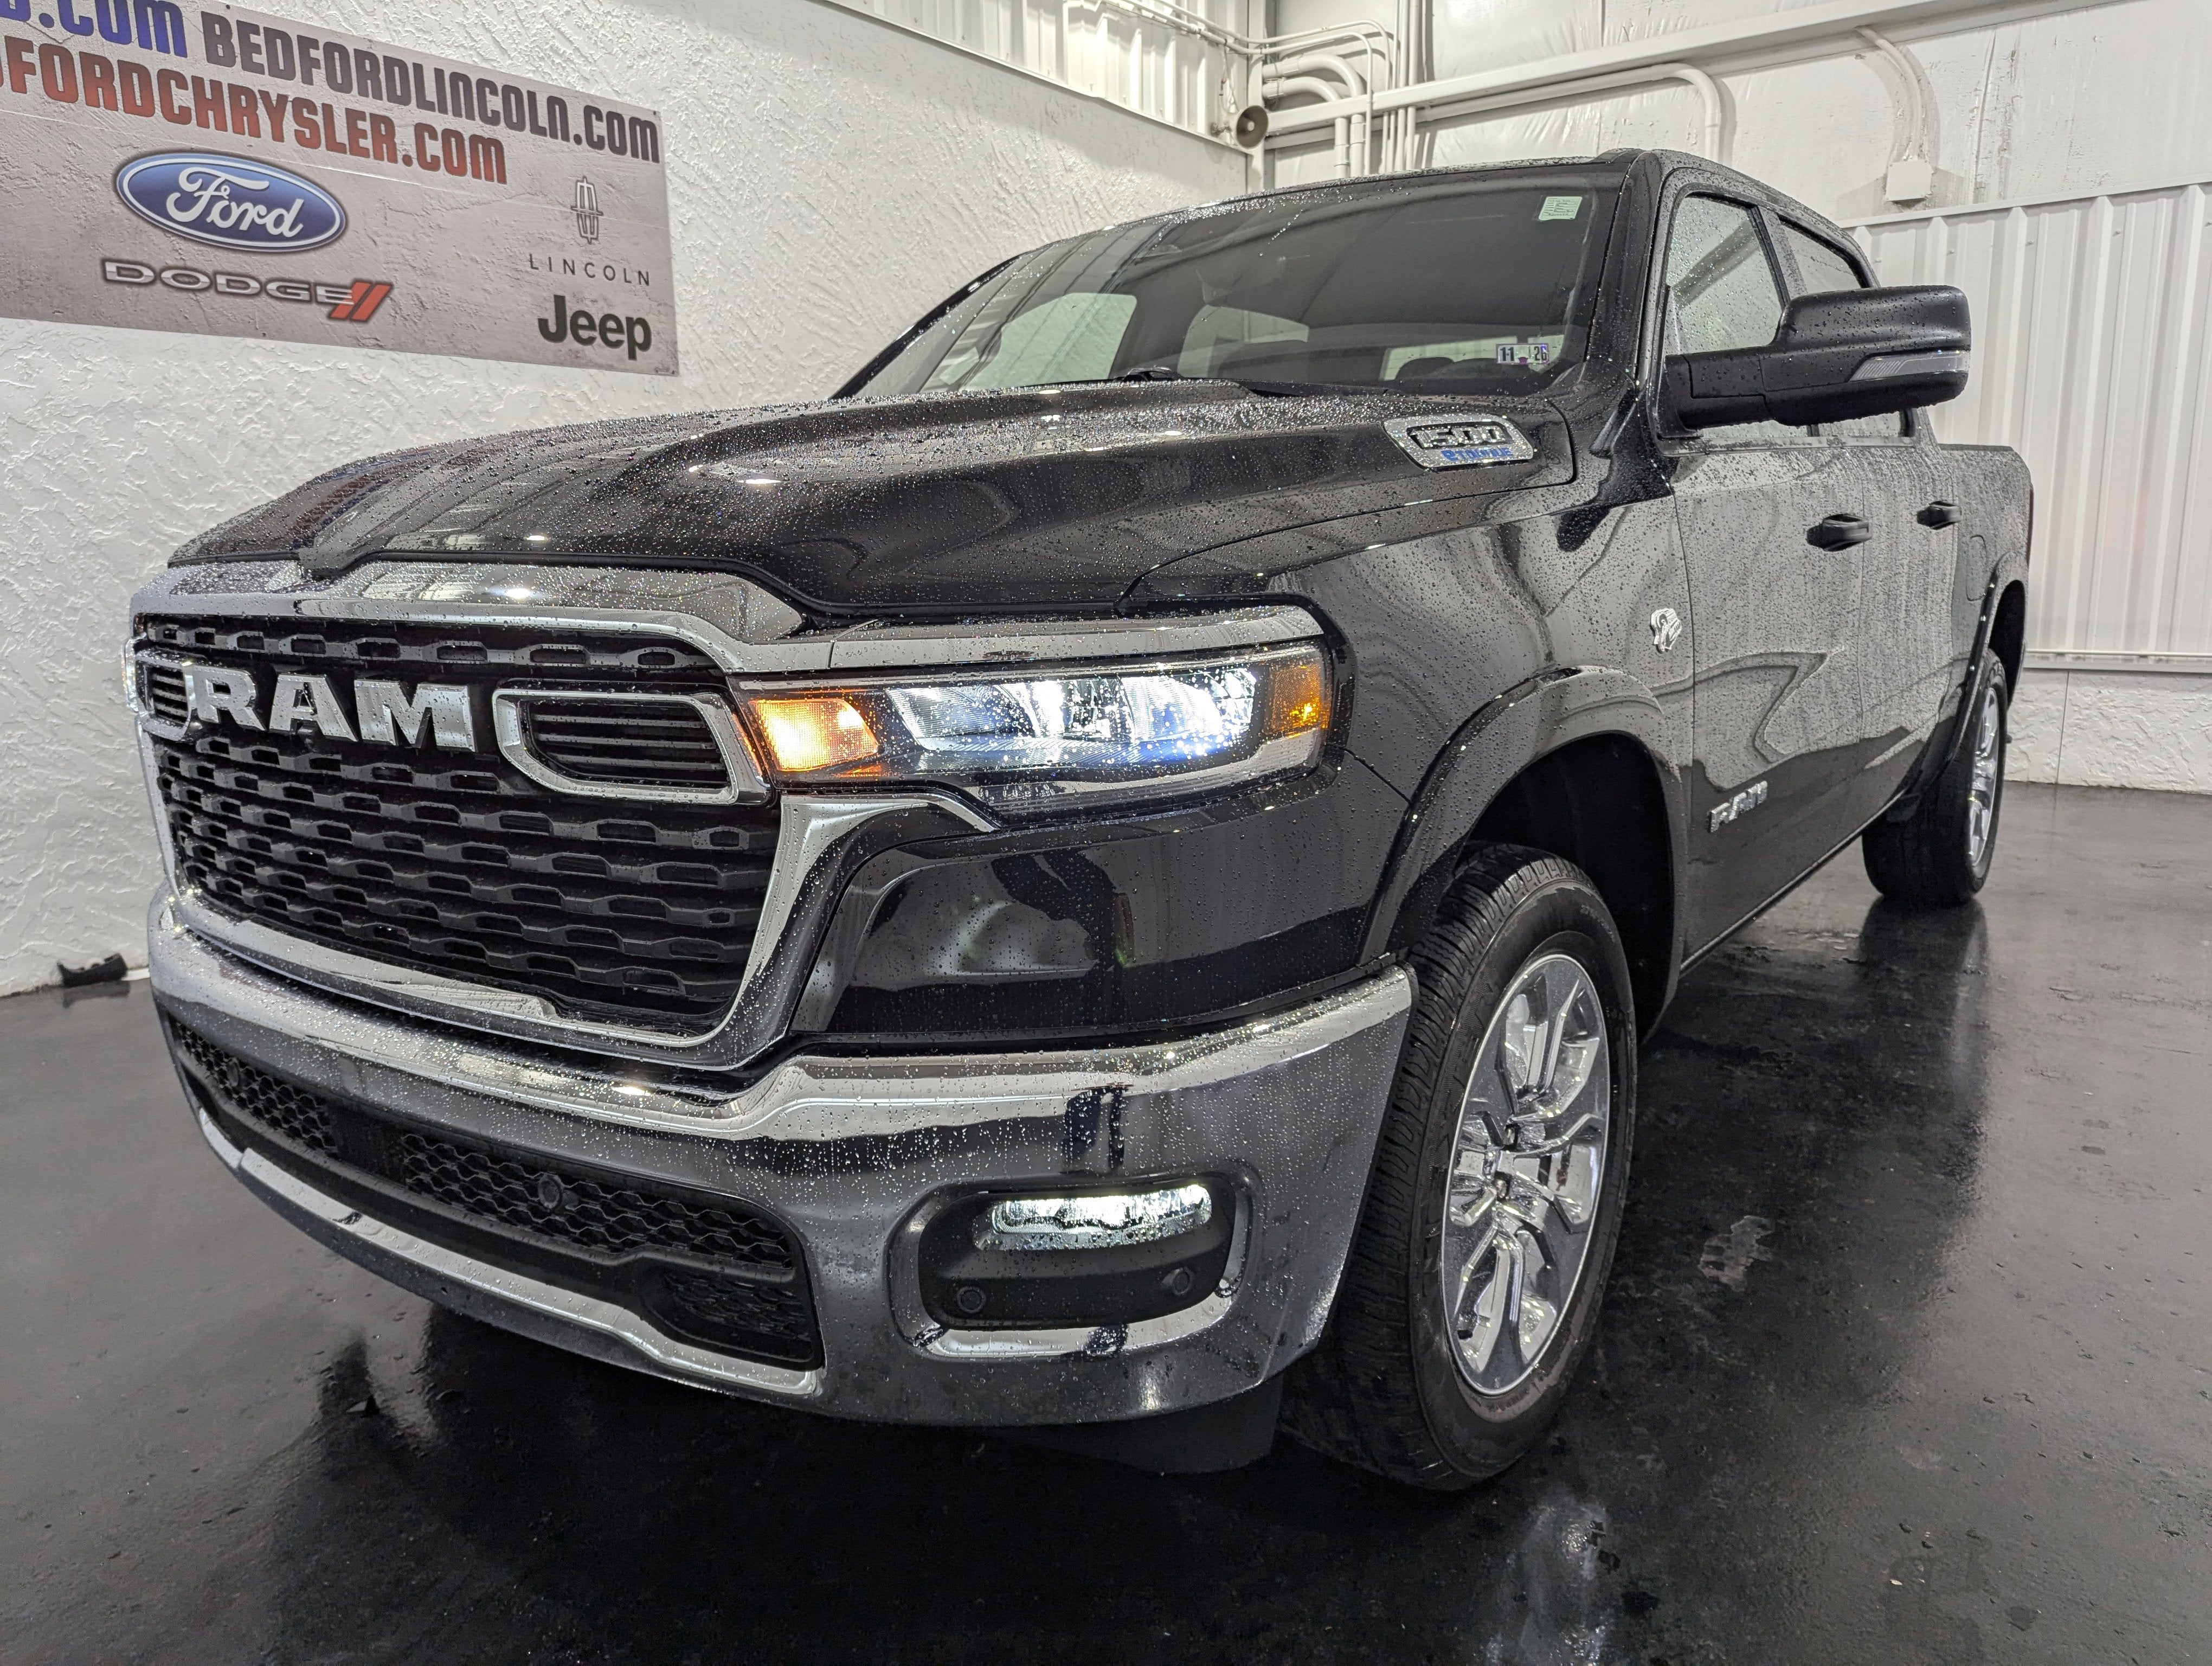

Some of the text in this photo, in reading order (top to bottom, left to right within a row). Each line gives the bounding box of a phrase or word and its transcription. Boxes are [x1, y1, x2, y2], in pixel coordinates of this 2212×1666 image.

[0, 35, 507, 185] FORDCHRYSLER.COM
[200, 11, 660, 163] BEDFORDLINCOLN.COM
[165, 166, 304, 238] Ford
[104, 261, 355, 305] DODGE
[529, 253, 650, 286] LINCOLN
[537, 294, 652, 361] Jeep
[185, 665, 476, 752] RAM
